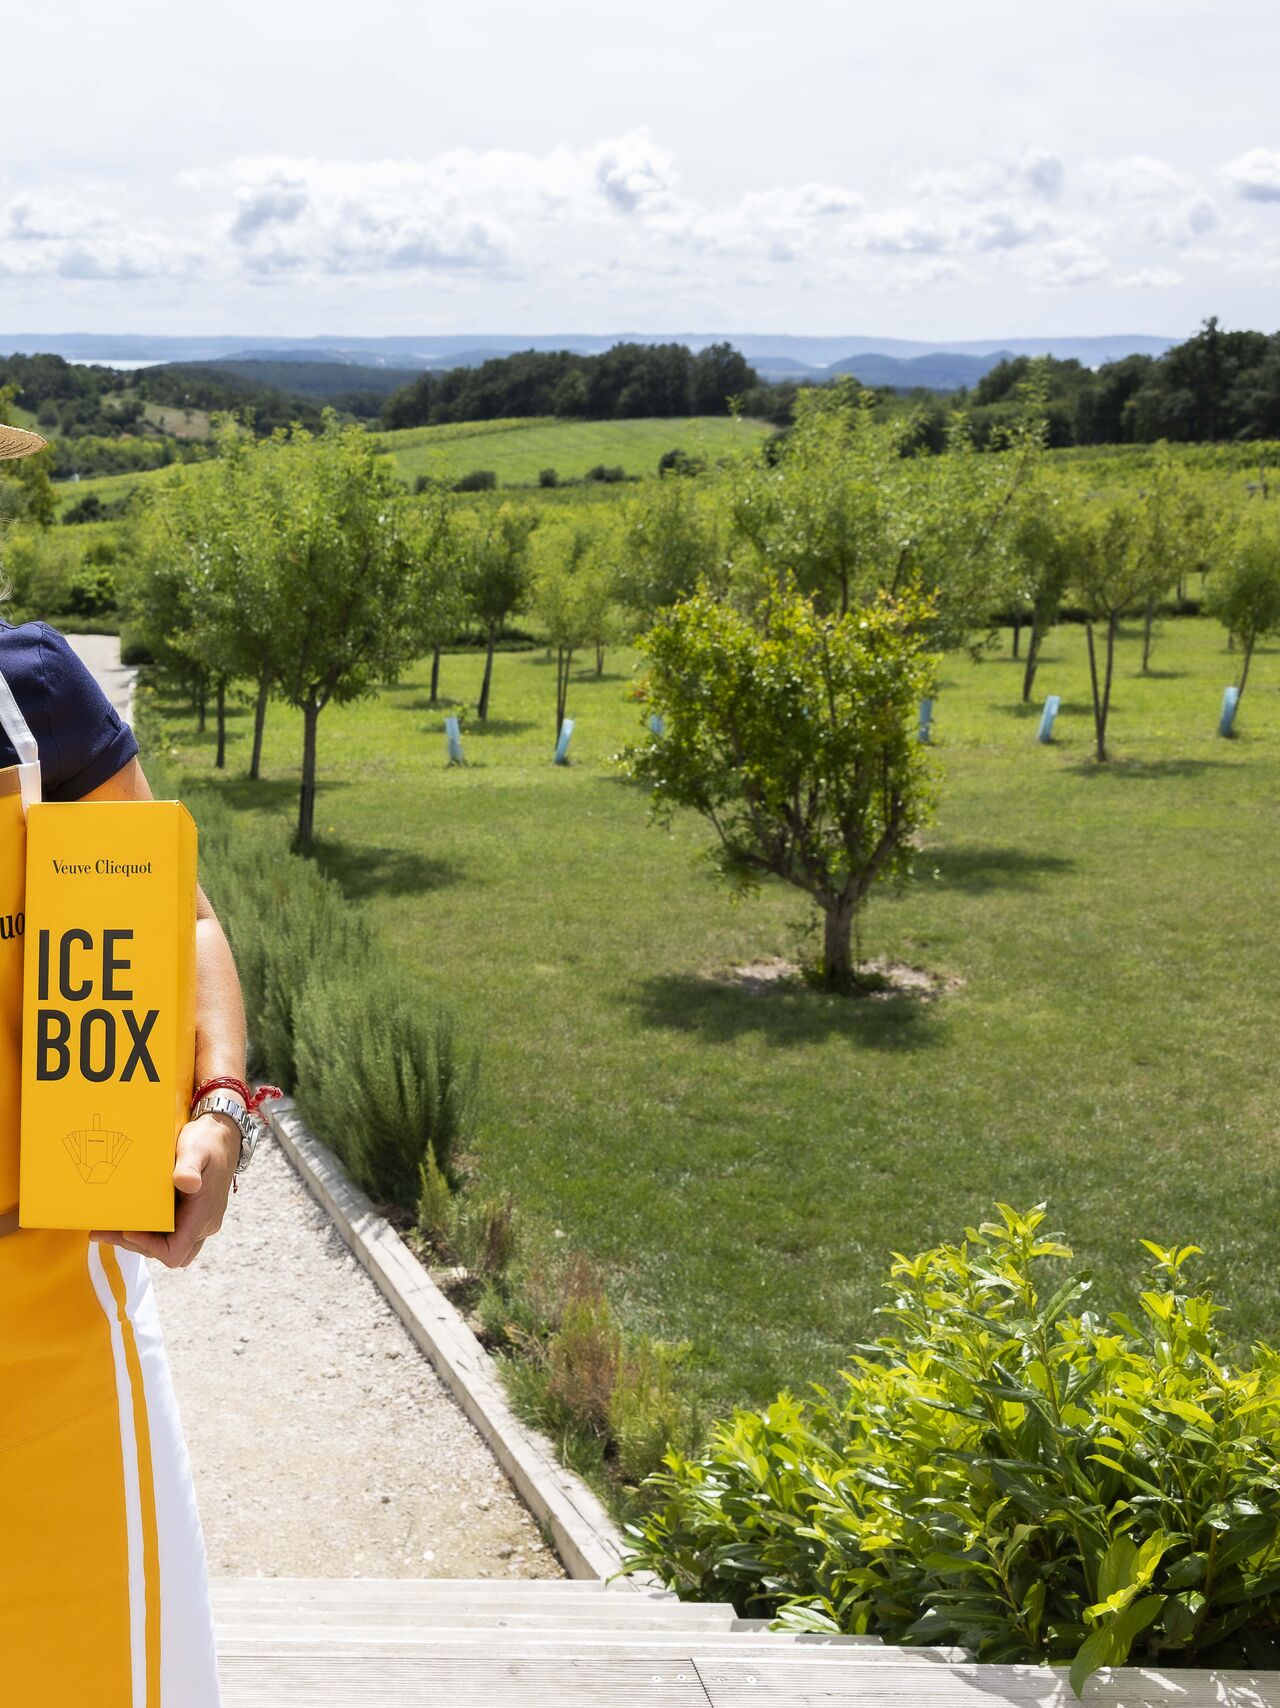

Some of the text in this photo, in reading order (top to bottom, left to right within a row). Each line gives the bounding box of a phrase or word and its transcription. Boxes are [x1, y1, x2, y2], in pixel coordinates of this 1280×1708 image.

[52, 859, 152, 878] Veuve Clicquot
[37, 928, 134, 1002] ICE
[36, 1008, 161, 1083] BOX
